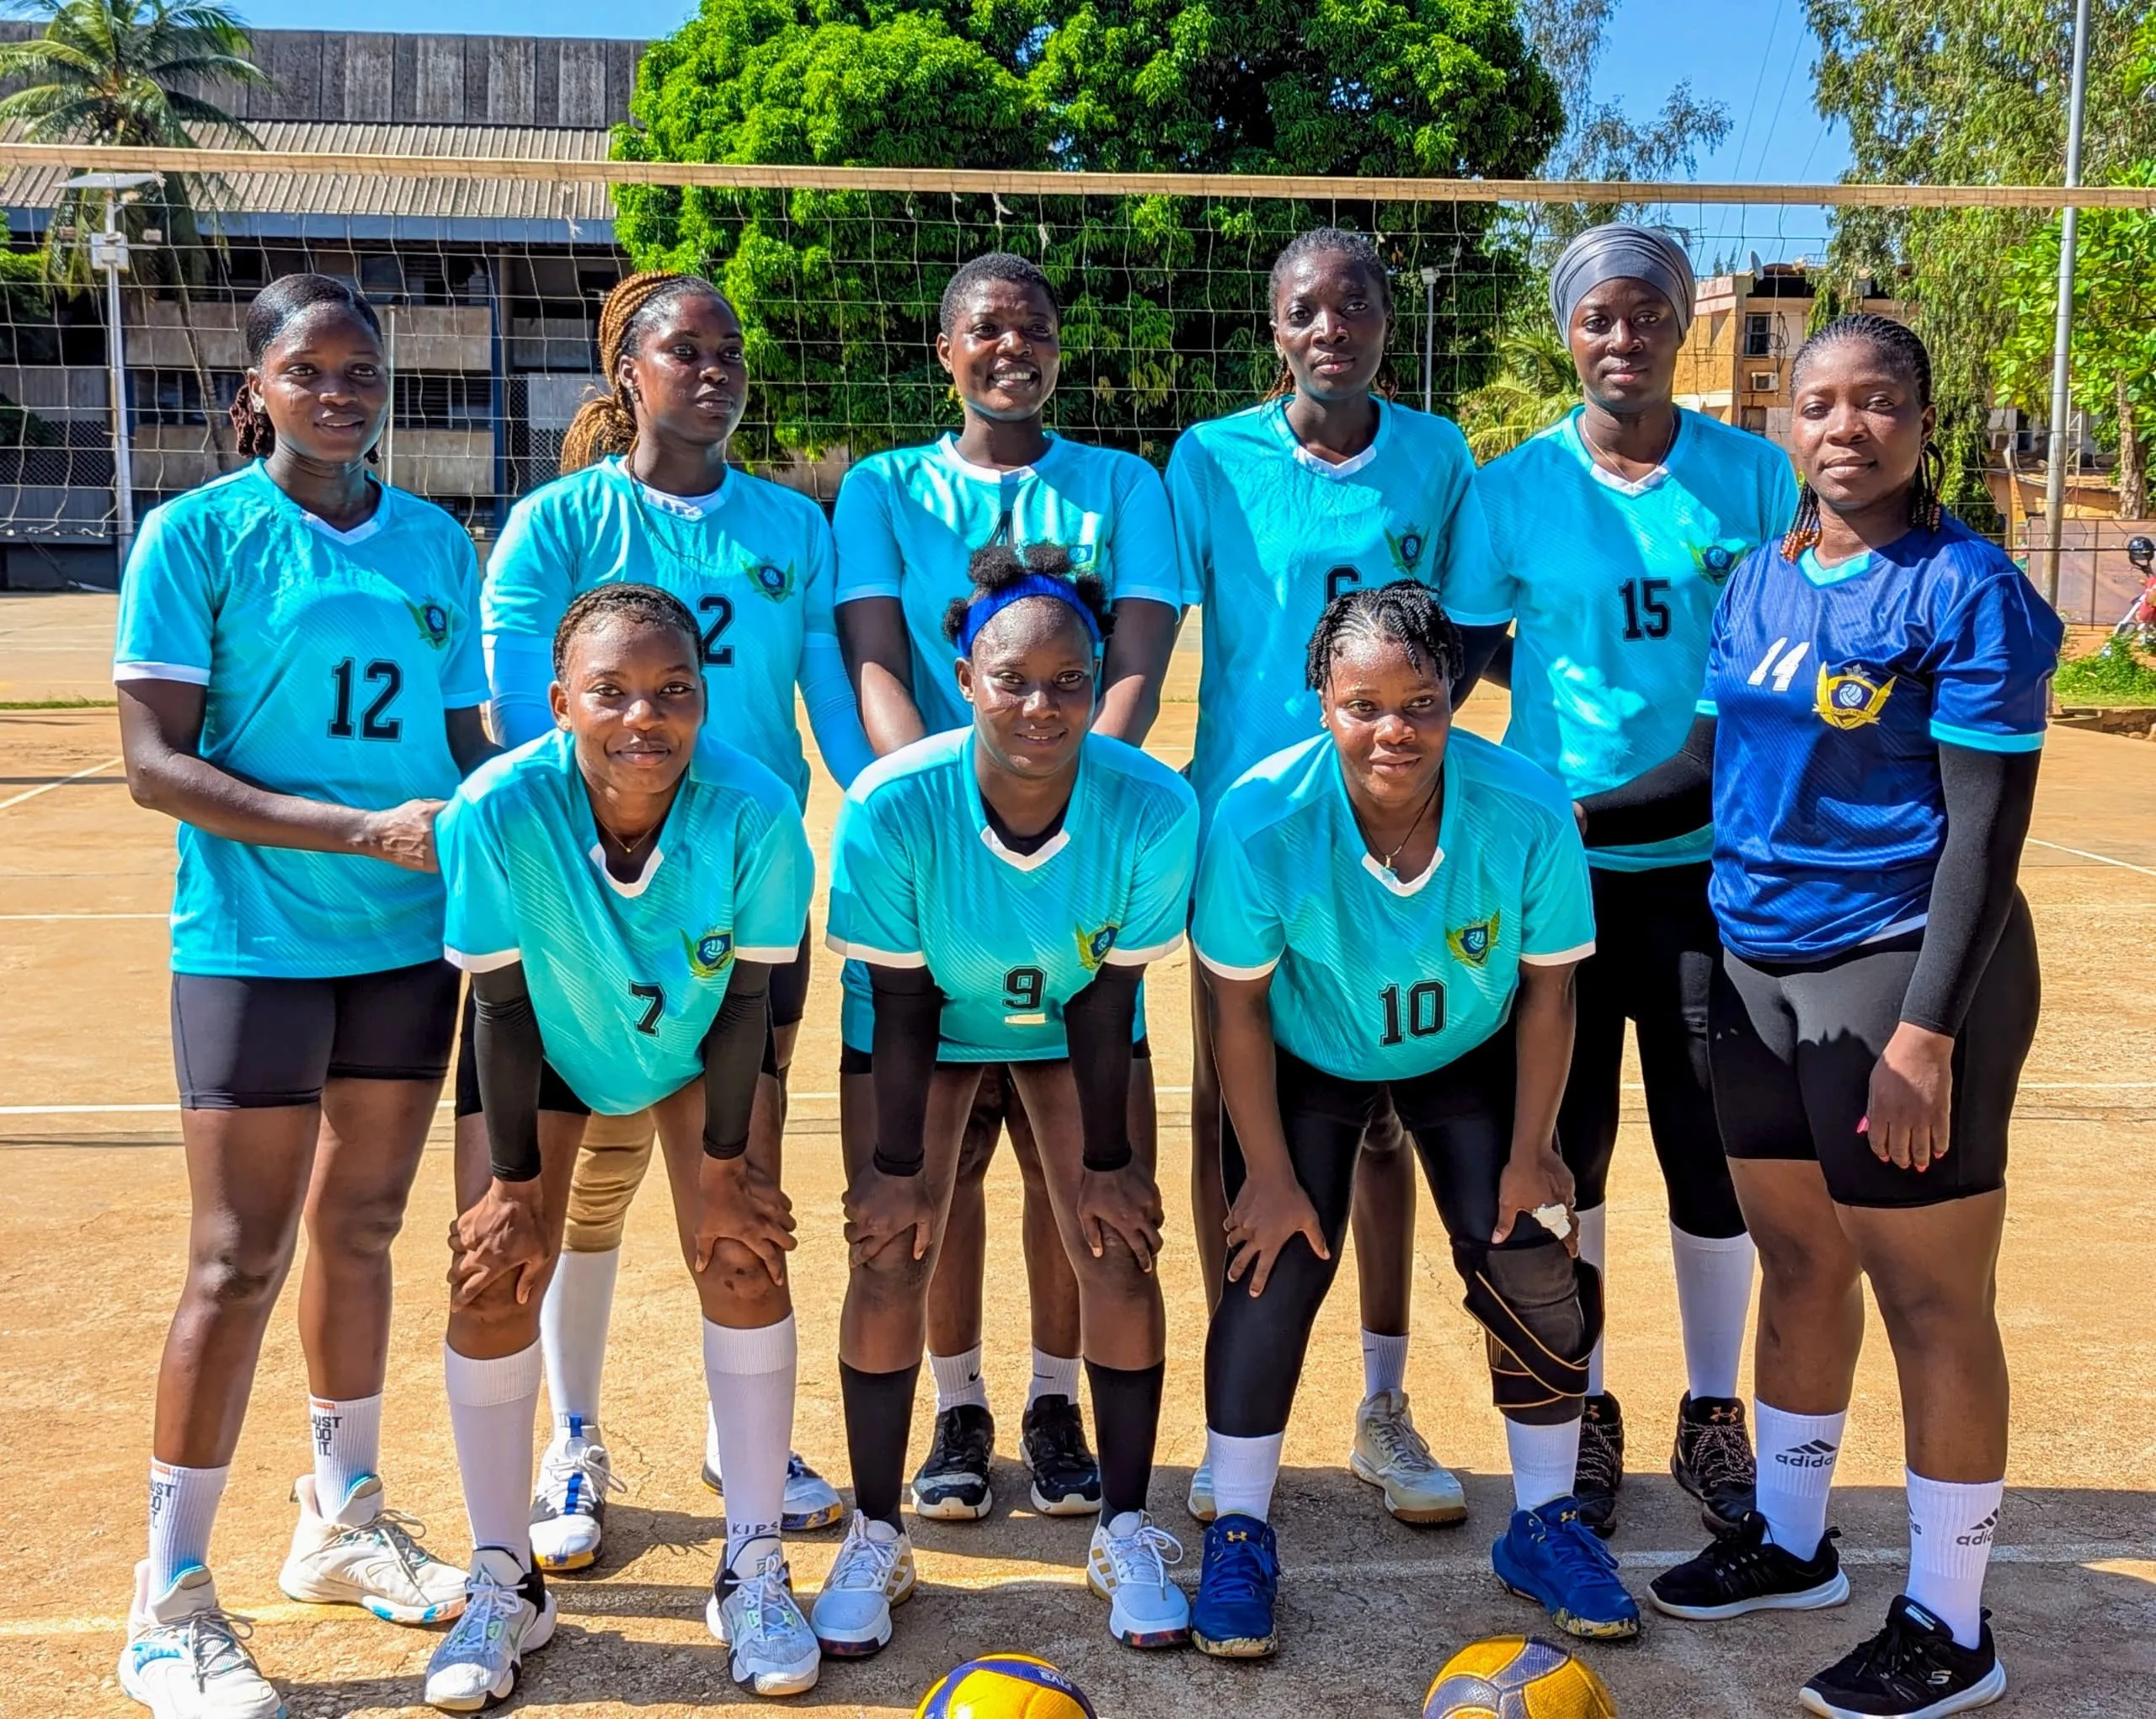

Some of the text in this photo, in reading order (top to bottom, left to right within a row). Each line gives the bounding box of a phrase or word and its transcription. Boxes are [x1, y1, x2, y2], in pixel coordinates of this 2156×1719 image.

[696, 593, 735, 668] 2
[1618, 577, 1671, 642] 15
[1747, 637, 1811, 691] 14
[327, 656, 403, 743] 12
[628, 978, 668, 1038] 7
[1002, 965, 1047, 1011] 9
[1377, 978, 1448, 1047] 10
[1775, 1453, 1838, 1468] adida
